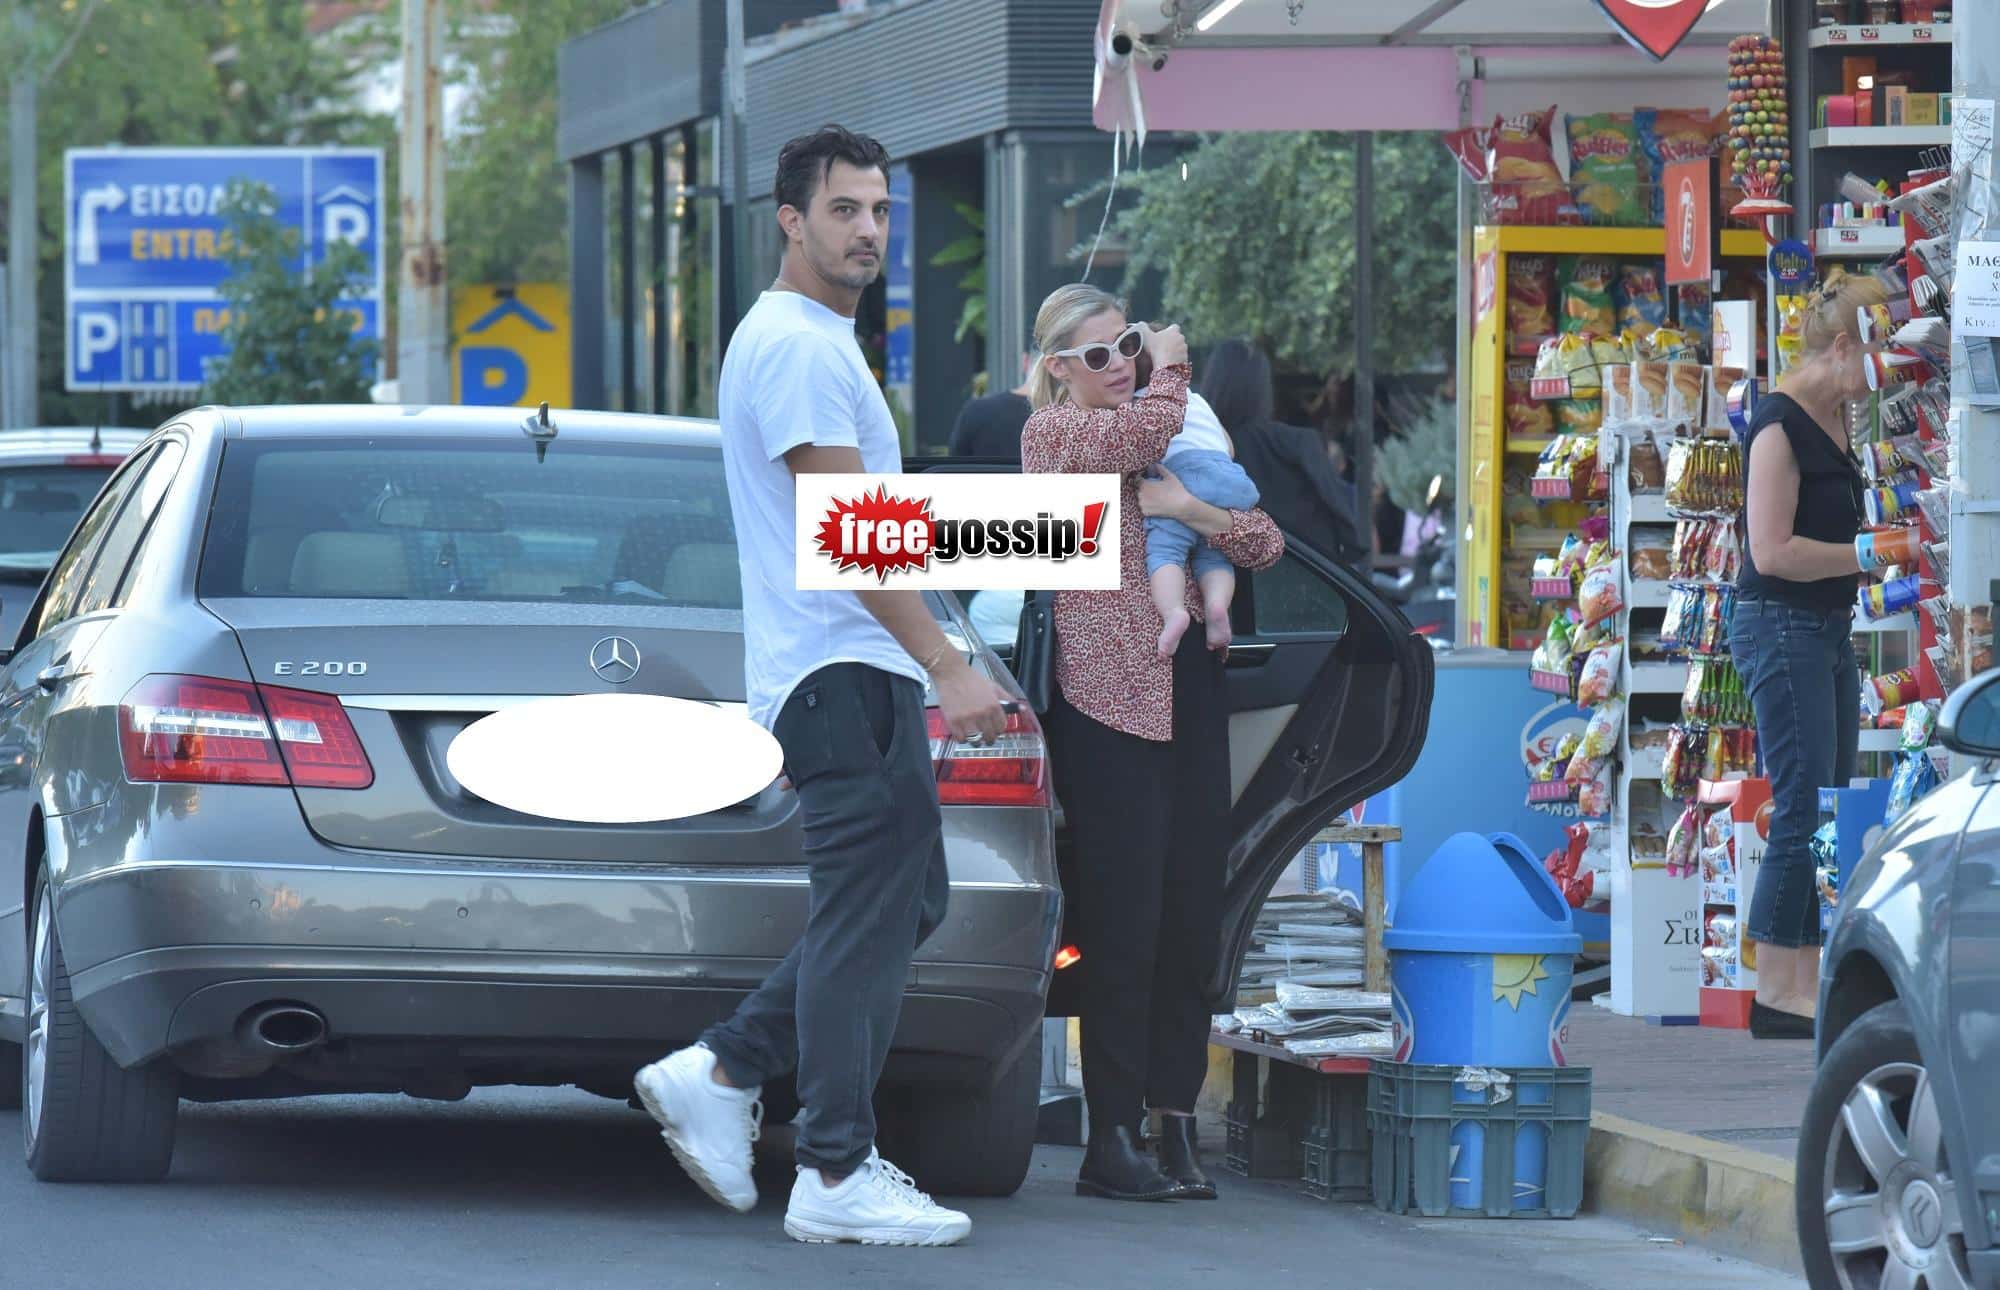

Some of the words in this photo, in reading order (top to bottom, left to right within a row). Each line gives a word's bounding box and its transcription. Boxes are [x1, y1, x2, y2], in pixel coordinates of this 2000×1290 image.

[77, 311, 119, 373] P
[460, 346, 529, 407] P
[274, 661, 294, 676] E
[300, 660, 368, 676] 200
